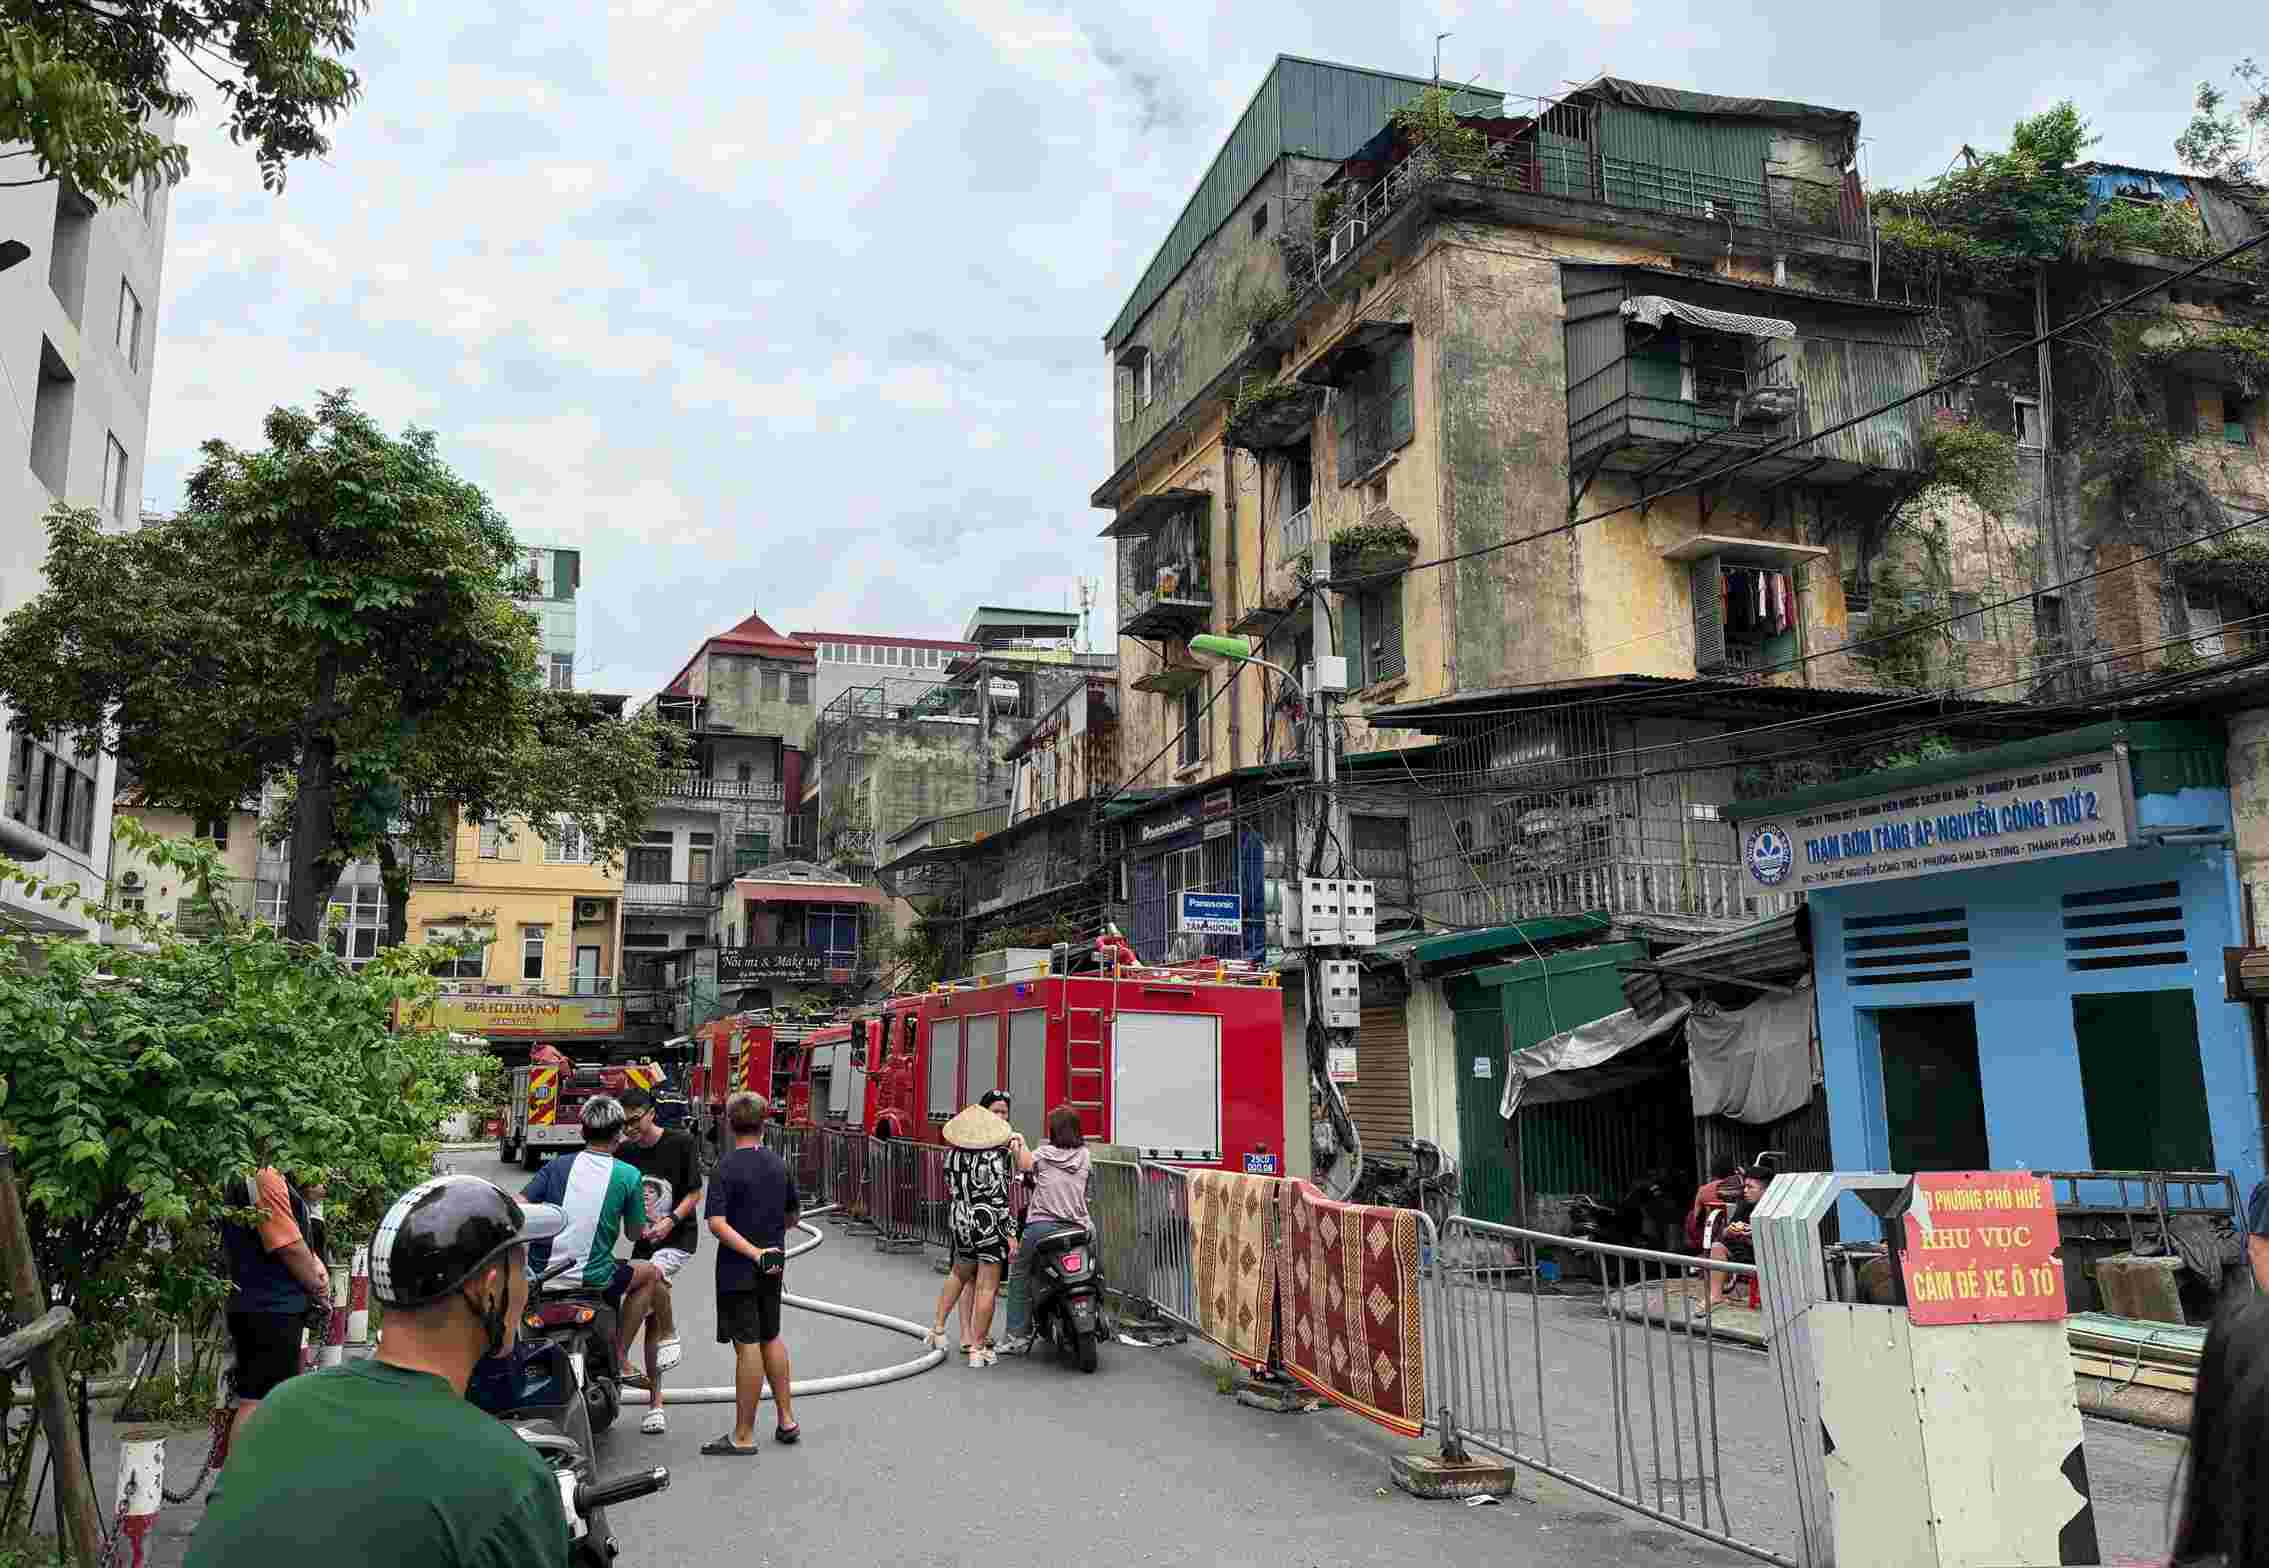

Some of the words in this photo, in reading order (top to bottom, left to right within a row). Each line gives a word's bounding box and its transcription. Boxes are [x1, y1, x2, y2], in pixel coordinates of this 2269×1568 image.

[2002, 796, 2048, 833] CÔNG
[2048, 785, 2085, 826] TRỨ
[2085, 790, 2098, 818] 2
[1188, 897, 1234, 910] Panasonic
[774, 952, 805, 970] Make
[806, 956, 822, 970] up
[1984, 1184, 2012, 1209] PHỐ
[2015, 1183, 2043, 1209] HUẾ
[1977, 1225, 2032, 1252] VỰC
[1983, 1268, 2008, 1299] XE
[2011, 1263, 2026, 1297] Ô
[2028, 1262, 2056, 1297] TÔ
